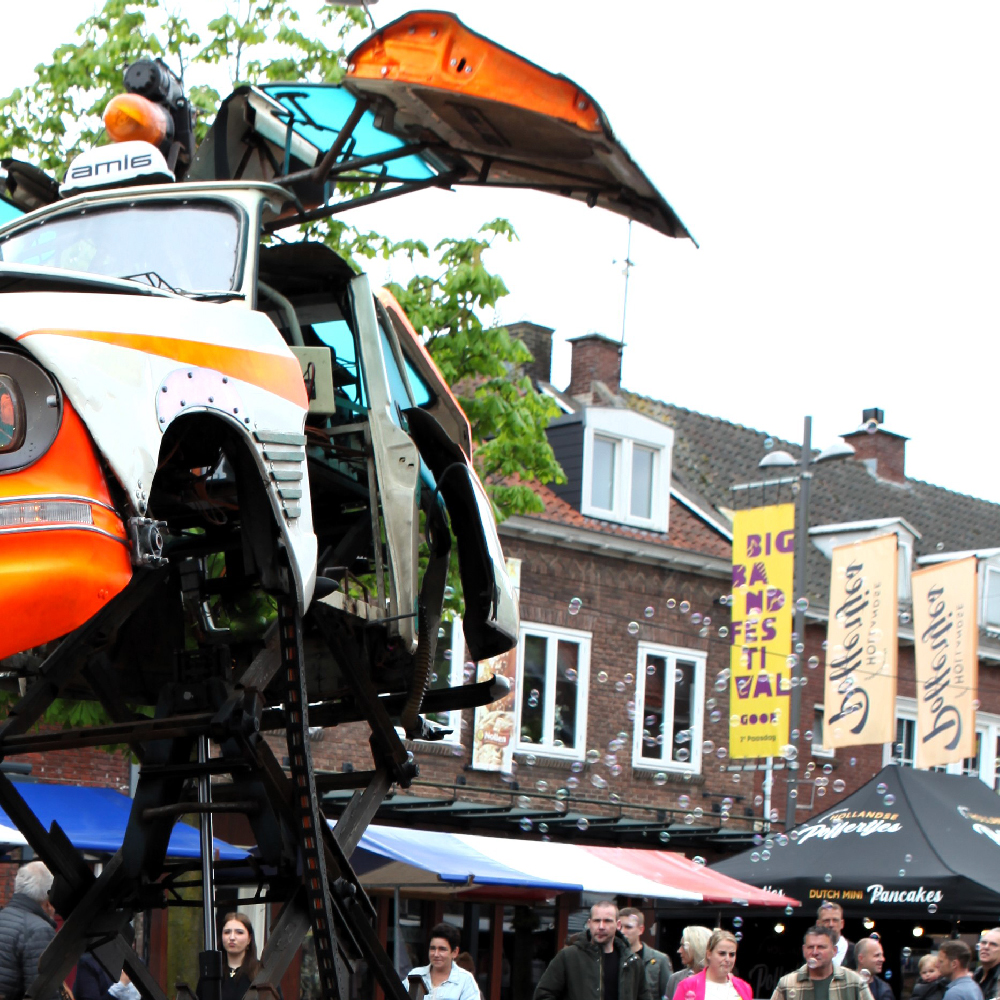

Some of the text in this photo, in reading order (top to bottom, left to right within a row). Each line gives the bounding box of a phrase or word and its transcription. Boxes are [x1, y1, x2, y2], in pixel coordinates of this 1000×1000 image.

[746, 530, 794, 557] BIG
[732, 562, 769, 588] BA
[745, 588, 785, 615] ND
[730, 617, 776, 645] FES
[742, 646, 766, 670] TI
[734, 673, 791, 699] VAL
[829, 811, 899, 820] HOLLANDSE
[797, 820, 902, 844] Poffertjes
[809, 884, 943, 904] DUTCH MINI Pancakes
